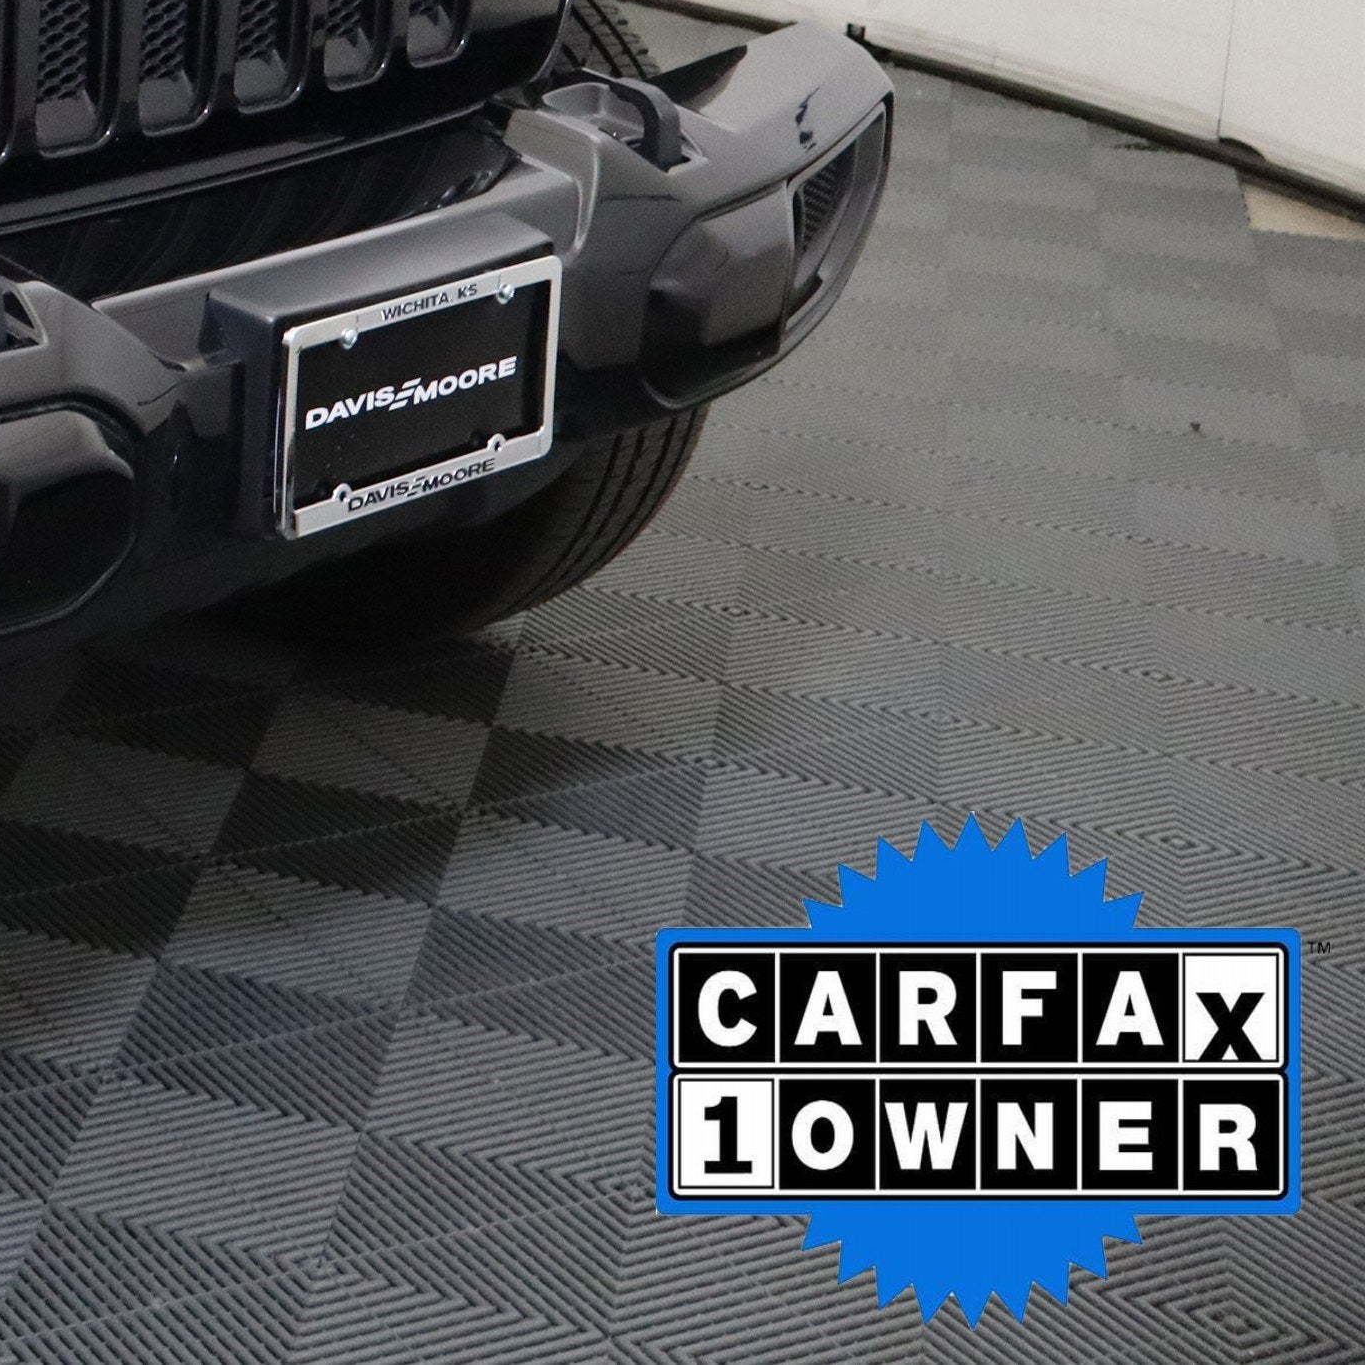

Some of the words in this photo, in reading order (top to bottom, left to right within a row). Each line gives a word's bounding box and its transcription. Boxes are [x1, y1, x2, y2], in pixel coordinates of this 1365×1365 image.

[457, 283, 478, 299] KS
[305, 386, 397, 431] DAVIS
[413, 356, 518, 406] MOORE
[347, 485, 411, 512] DAVIS
[421, 457, 496, 493] MOORE
